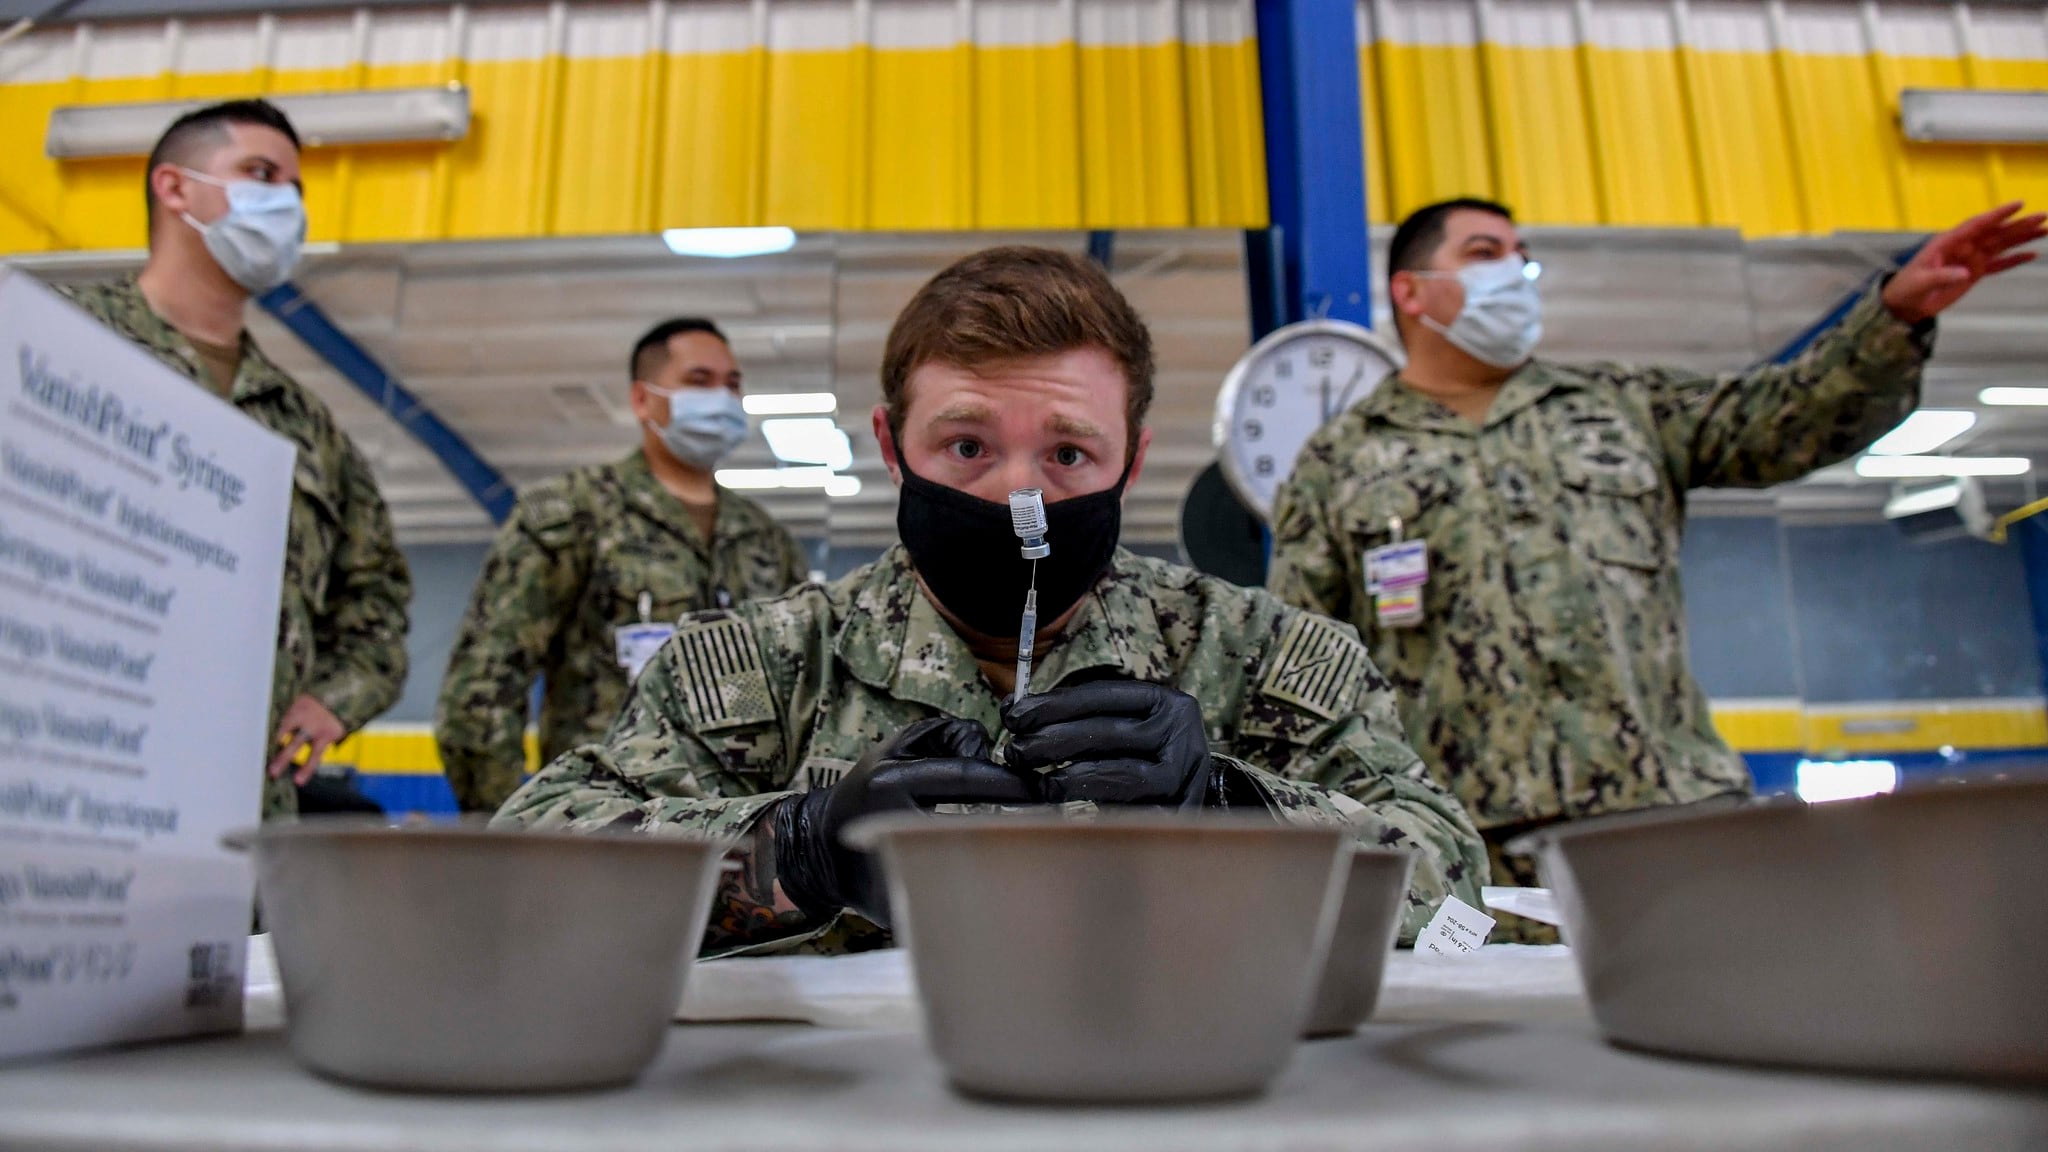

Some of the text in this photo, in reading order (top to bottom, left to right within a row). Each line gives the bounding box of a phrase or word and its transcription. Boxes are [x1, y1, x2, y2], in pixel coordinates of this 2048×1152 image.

[1308, 347, 1333, 368] 12
[1250, 384, 1277, 409] 10
[1244, 418, 1263, 442] 9
[167, 431, 246, 513] Syringe
[1255, 454, 1275, 478] 8
